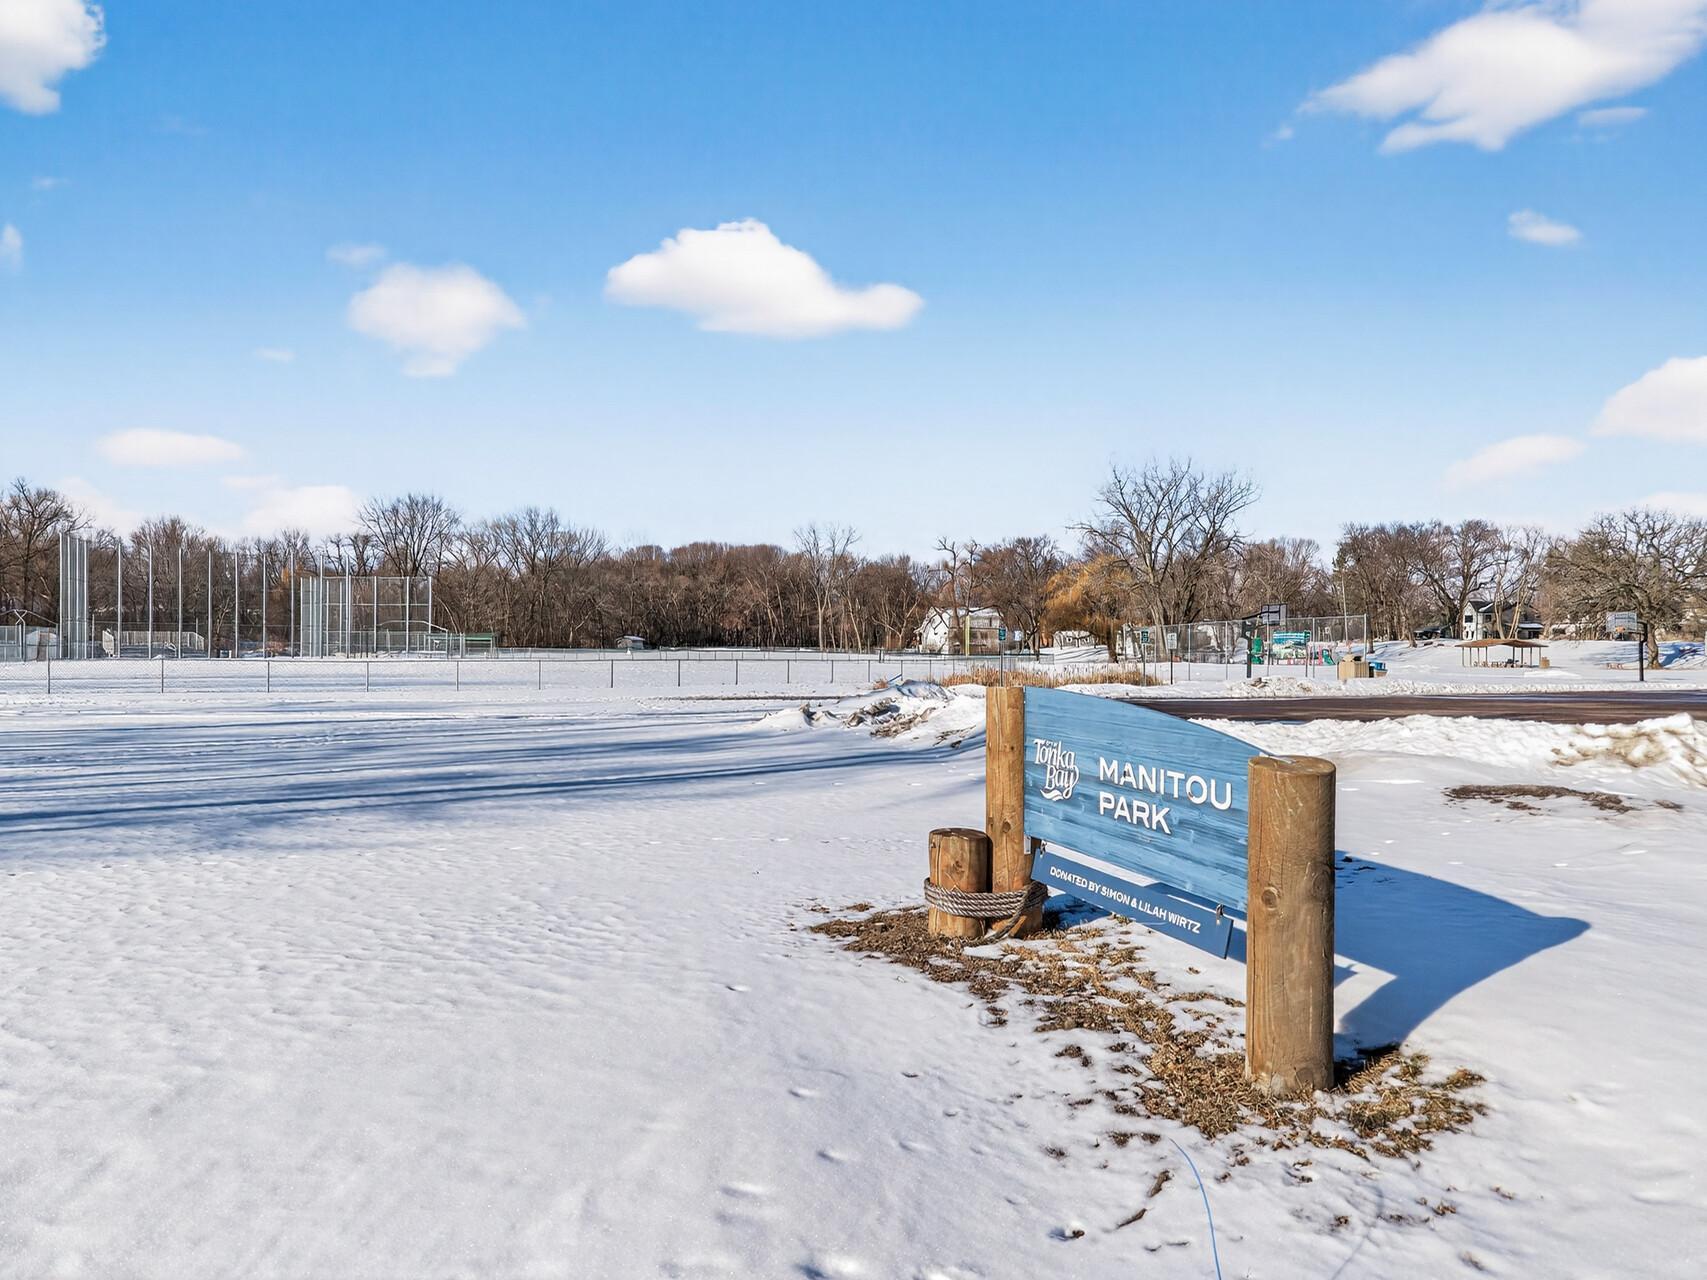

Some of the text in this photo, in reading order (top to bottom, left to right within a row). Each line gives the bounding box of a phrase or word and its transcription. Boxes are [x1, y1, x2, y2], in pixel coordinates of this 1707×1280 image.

[1033, 739, 1075, 769] Tonka
[1045, 765, 1079, 799] Bay
[1099, 756, 1232, 810] MANITOU
[1099, 791, 1171, 834] PARK
[1050, 866, 1201, 934] DONATED BY SIMON & LILAH WIRTZ
